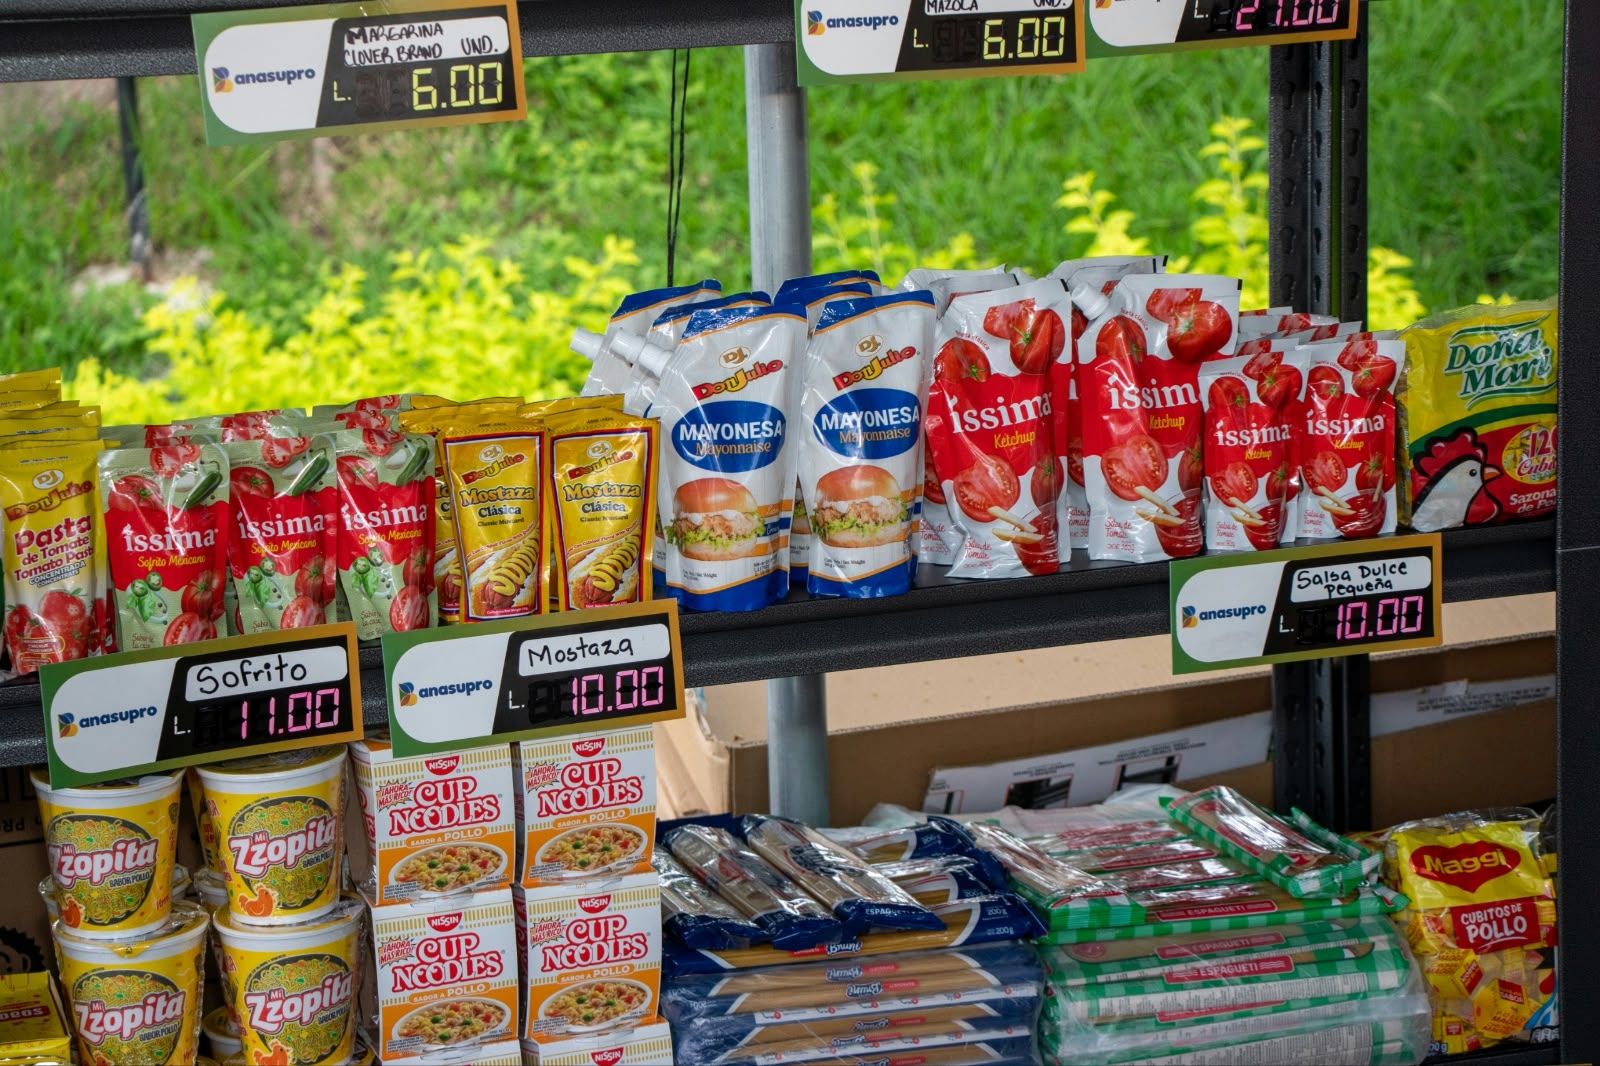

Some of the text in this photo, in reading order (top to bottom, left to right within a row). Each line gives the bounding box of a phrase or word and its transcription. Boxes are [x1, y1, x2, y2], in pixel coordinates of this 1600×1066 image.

[826, 13, 899, 30] anasupro
[346, 22, 444, 46] MARGARINA
[913, 16, 1065, 60] L. 6.00
[344, 35, 498, 66] CLOVER BRAND UND.
[234, 67, 316, 85] anasupro
[333, 61, 502, 110] L. 6.00
[1444, 328, 1541, 373] Doña
[1459, 347, 1551, 396] Mari
[821, 405, 920, 431] MAYONESA
[1150, 415, 1186, 430] Ketchup
[679, 418, 783, 441] MAYONESA
[839, 426, 911, 445] Mayonnaise
[695, 440, 772, 456] Mayonnaise
[994, 430, 1036, 449] Ketchup
[1334, 438, 1364, 452] Ketchup
[1244, 447, 1273, 462] Ketchup
[459, 486, 535, 507] Mostaza
[563, 482, 641, 501] Mostaza
[478, 504, 522, 518] Clásica
[581, 500, 627, 514] Clásica
[1517, 503, 1534, 514] de
[14, 514, 92, 556] Pasta
[388, 528, 422, 541] Mexicano
[22, 535, 90, 566] de Tomate
[280, 538, 317, 551] Mexicano
[14, 557, 64, 581] Tomato
[137, 553, 206, 571] Sofrito Mexicano
[1297, 561, 1408, 589] Salsa Dulce
[1199, 604, 1267, 621] anasupro
[1279, 595, 1423, 640] L. 10.00
[528, 636, 634, 668] Mostaza
[196, 654, 307, 695] Sofrito
[418, 678, 493, 699] anasupro
[508, 665, 664, 716] L. 10.00
[78, 705, 158, 729] anasupro
[173, 687, 340, 740] L. 11.00
[576, 741, 602, 752] NISSIN
[429, 759, 457, 770] NISSIN
[561, 758, 621, 790] CUP
[413, 776, 477, 807] CUP
[537, 776, 643, 817] NOODLES
[389, 794, 501, 836] NOODLES
[557, 819, 581, 828] SABOR
[589, 809, 626, 823] POLLO
[254, 832, 267, 842] Mi
[410, 837, 435, 846] SABOR
[444, 828, 483, 841] POLLO
[63, 844, 75, 854] Mi
[1423, 848, 1507, 875] Maggi
[581, 898, 609, 908] NISSIN
[1187, 905, 1246, 916] ESPAGUETI
[431, 916, 459, 927] NISSIN
[1460, 902, 1523, 924] CUBITOS DE
[566, 914, 627, 946] CUP
[1467, 916, 1528, 944] POLLO
[415, 932, 480, 963] CUP
[541, 933, 648, 972] NOODLES
[1191, 938, 1250, 951] ESPAGUETI
[392, 949, 503, 993] NOODLES
[560, 973, 585, 982] SABOR
[593, 965, 630, 978] POLLO
[1200, 962, 1258, 977] ESPAGUETI
[270, 988, 284, 1000] Mi
[413, 993, 438, 1002] SABOR
[447, 983, 486, 997] POLLO
[92, 1001, 104, 1011] Mi
[594, 1051, 621, 1062] NISSIN
